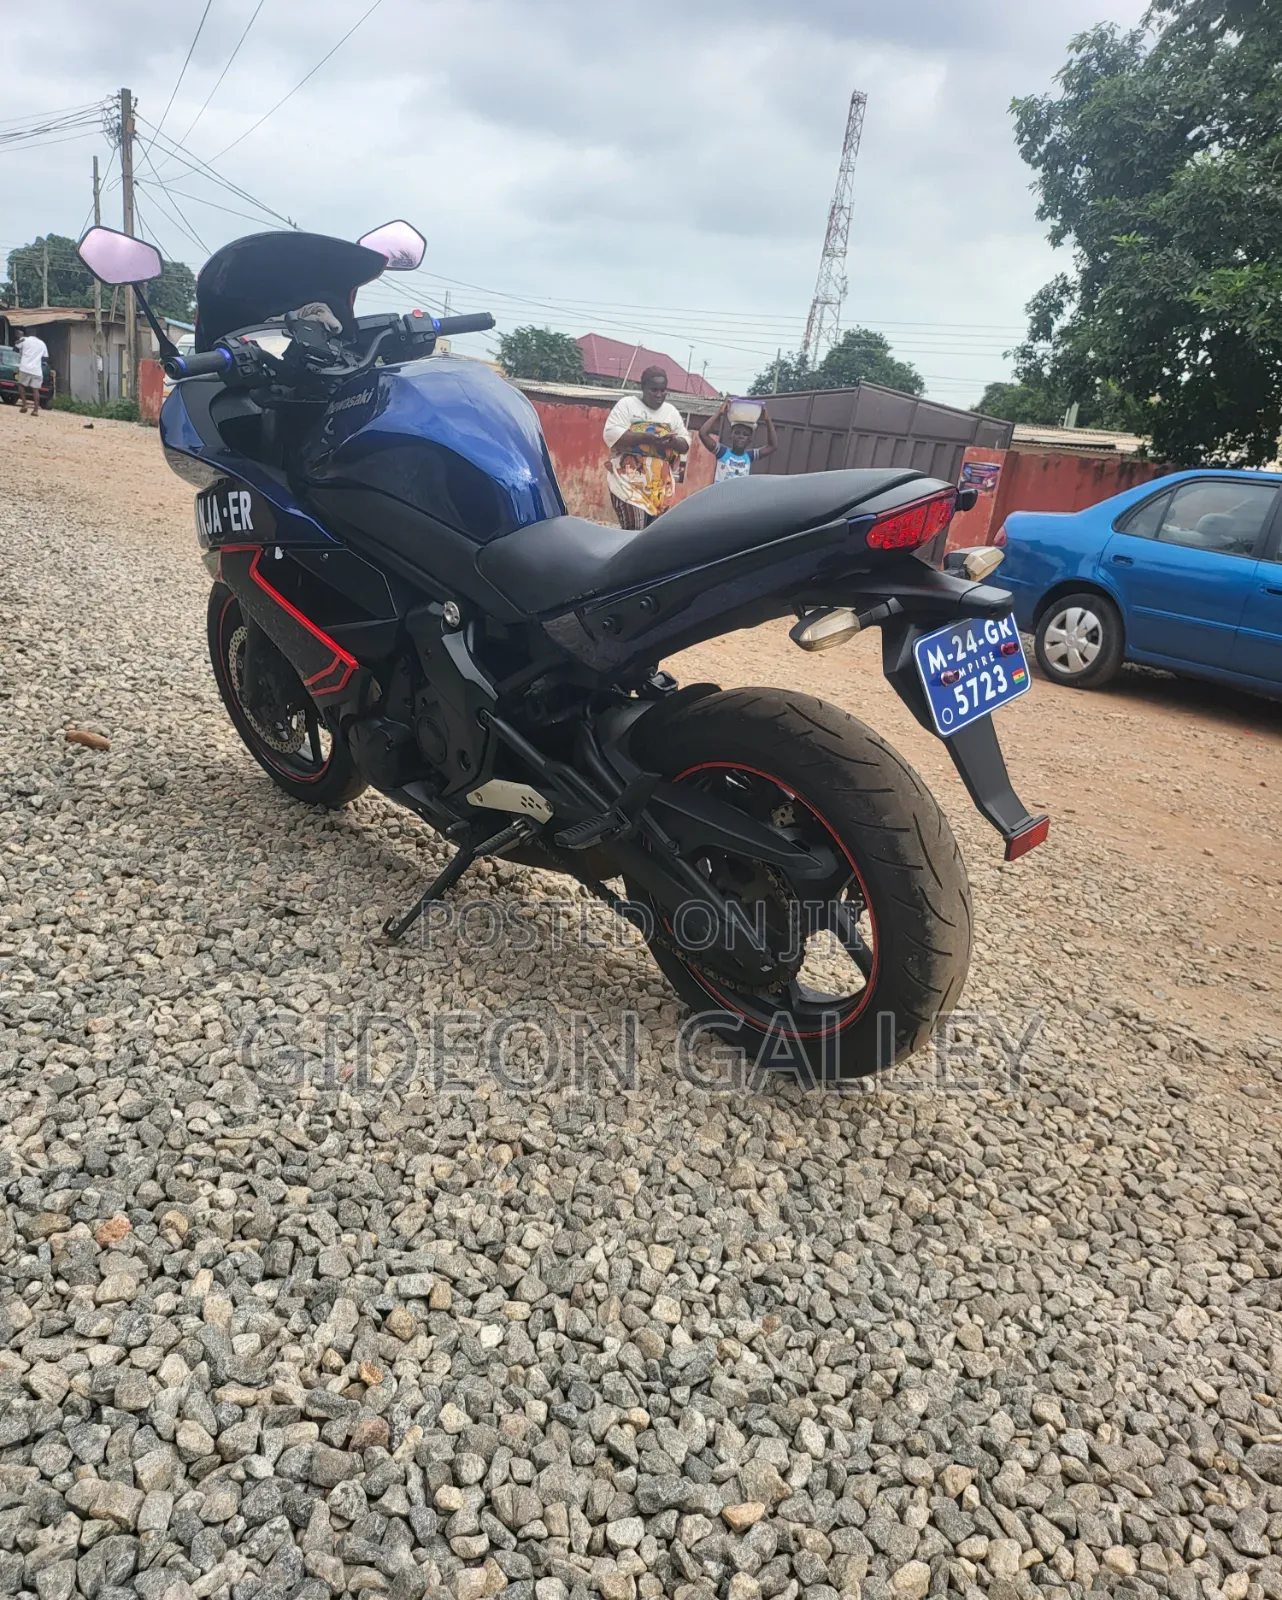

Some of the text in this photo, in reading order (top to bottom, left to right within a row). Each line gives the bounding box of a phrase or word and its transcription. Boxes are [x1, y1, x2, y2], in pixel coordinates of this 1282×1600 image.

[324, 387, 375, 416] Kawasaki
[958, 651, 995, 679] MPIRE
[953, 664, 1008, 715] 5723
